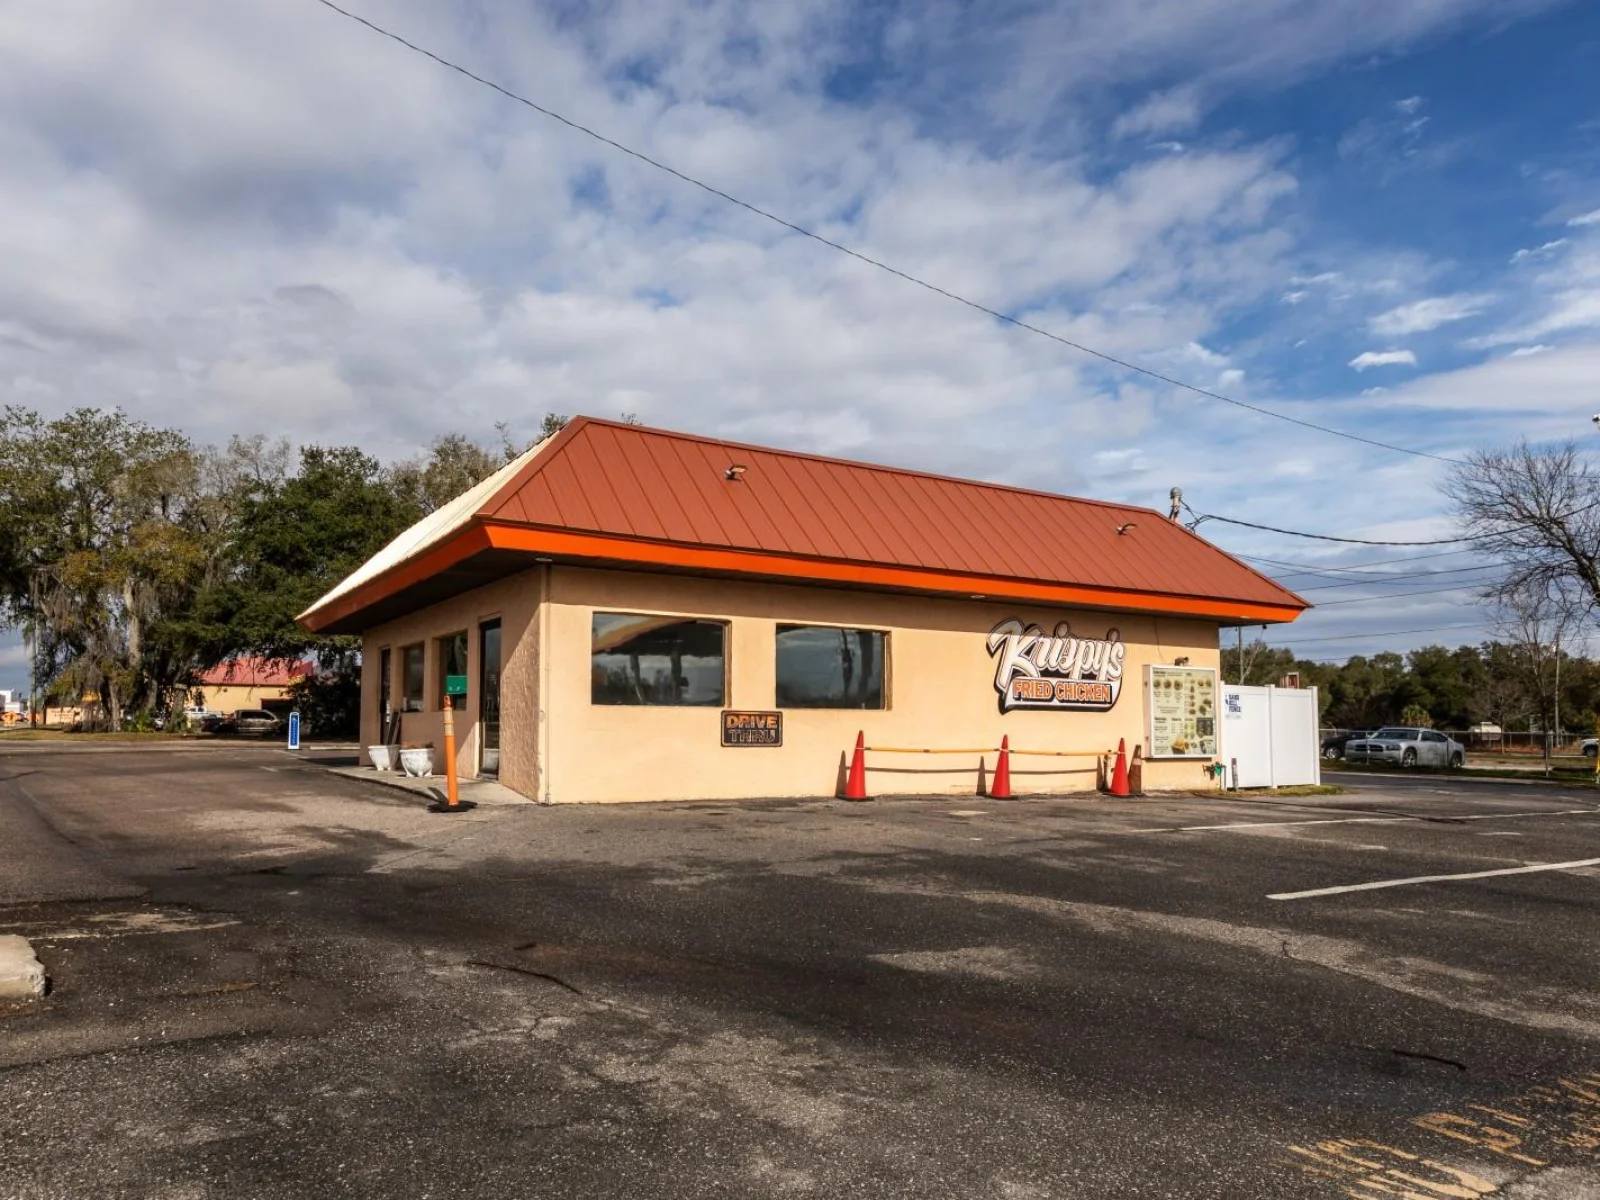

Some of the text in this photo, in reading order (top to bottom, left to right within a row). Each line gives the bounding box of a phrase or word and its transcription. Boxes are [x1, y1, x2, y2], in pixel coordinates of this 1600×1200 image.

[1013, 679, 1112, 703] FRIED CHICKEN
[726, 714, 778, 729] DRIVE
[728, 729, 776, 743] THRU
